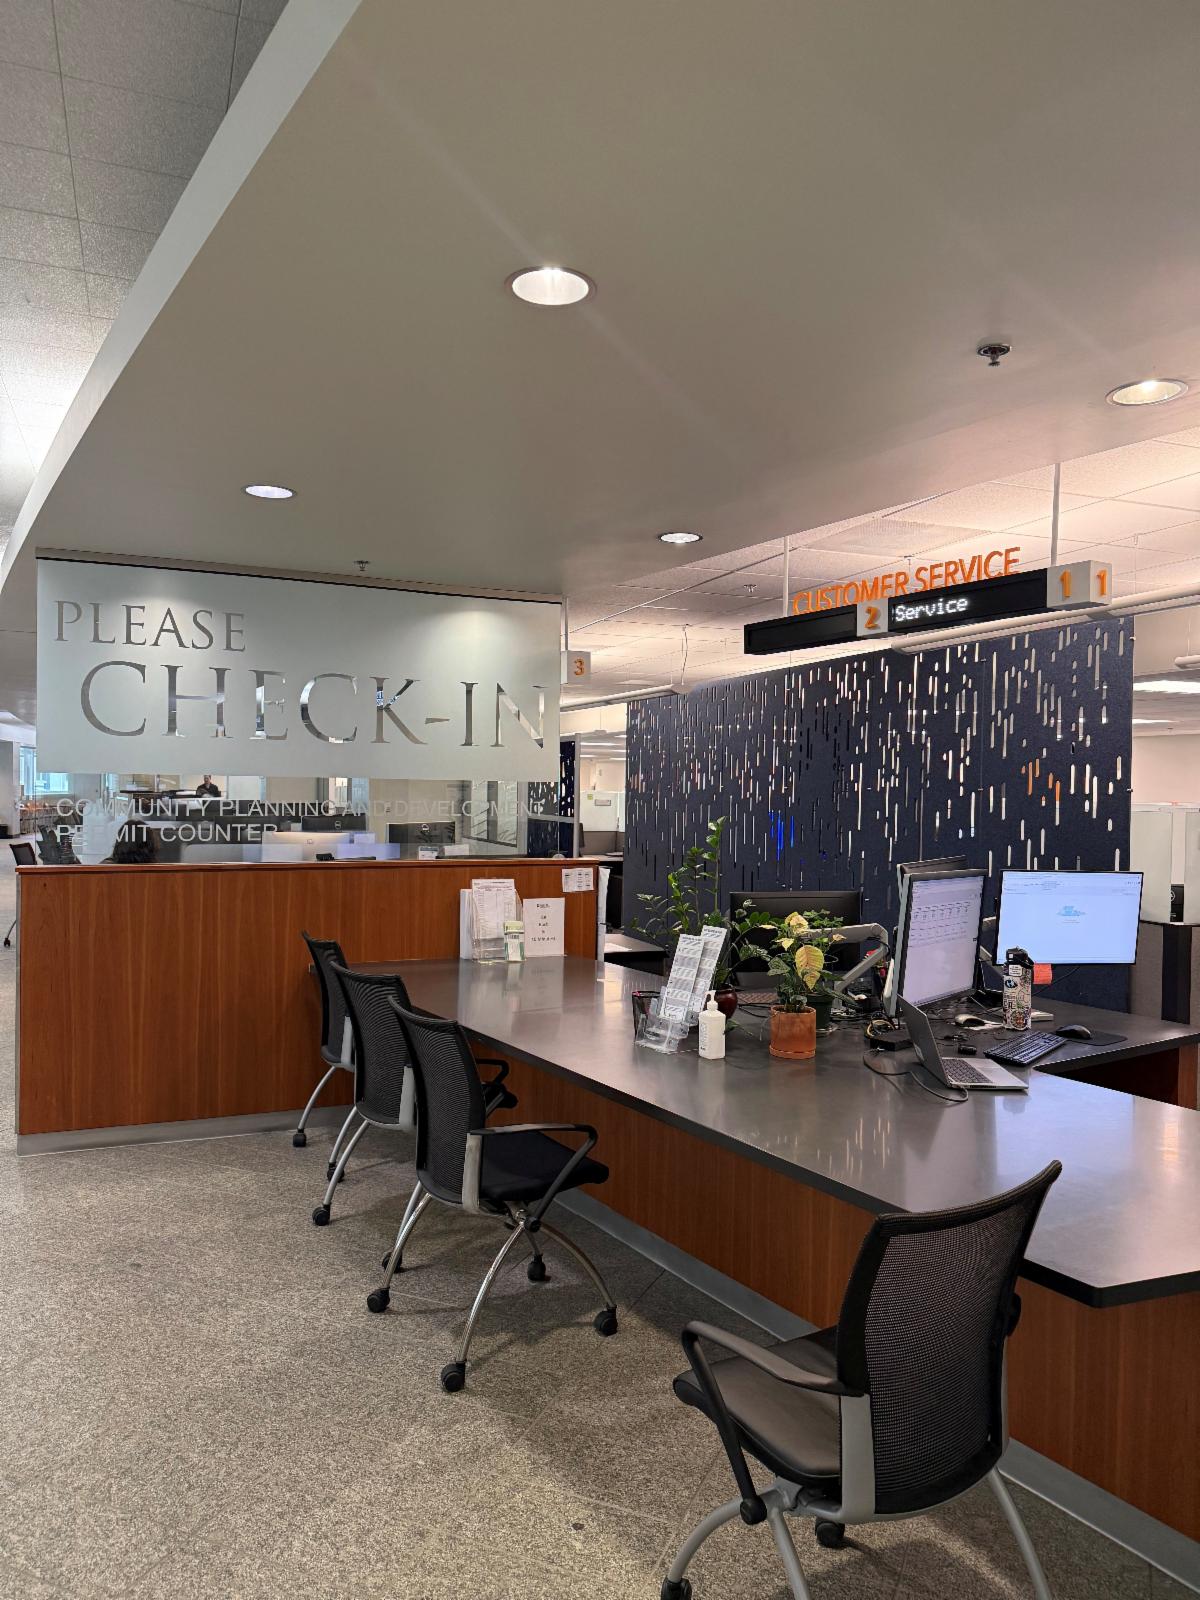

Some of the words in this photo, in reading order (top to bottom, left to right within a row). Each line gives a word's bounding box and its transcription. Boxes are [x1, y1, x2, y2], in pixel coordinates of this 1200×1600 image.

[792, 571, 910, 615] CUSTOMER
[914, 547, 1021, 592] SERVICE
[1059, 570, 1071, 598] 1
[1096, 569, 1107, 597] 1
[864, 606, 879, 629] 2
[895, 598, 968, 621] Service
[55, 600, 246, 652] PLEASE
[574, 658, 585, 676] 3
[80, 660, 547, 749] CHECK-IN
[219, 799, 336, 817] PLANNING
[341, 800, 386, 817] AND
[394, 800, 544, 817] DEVELOMENT
[56, 824, 149, 843] PEMIT
[160, 824, 278, 843] COUNTER
